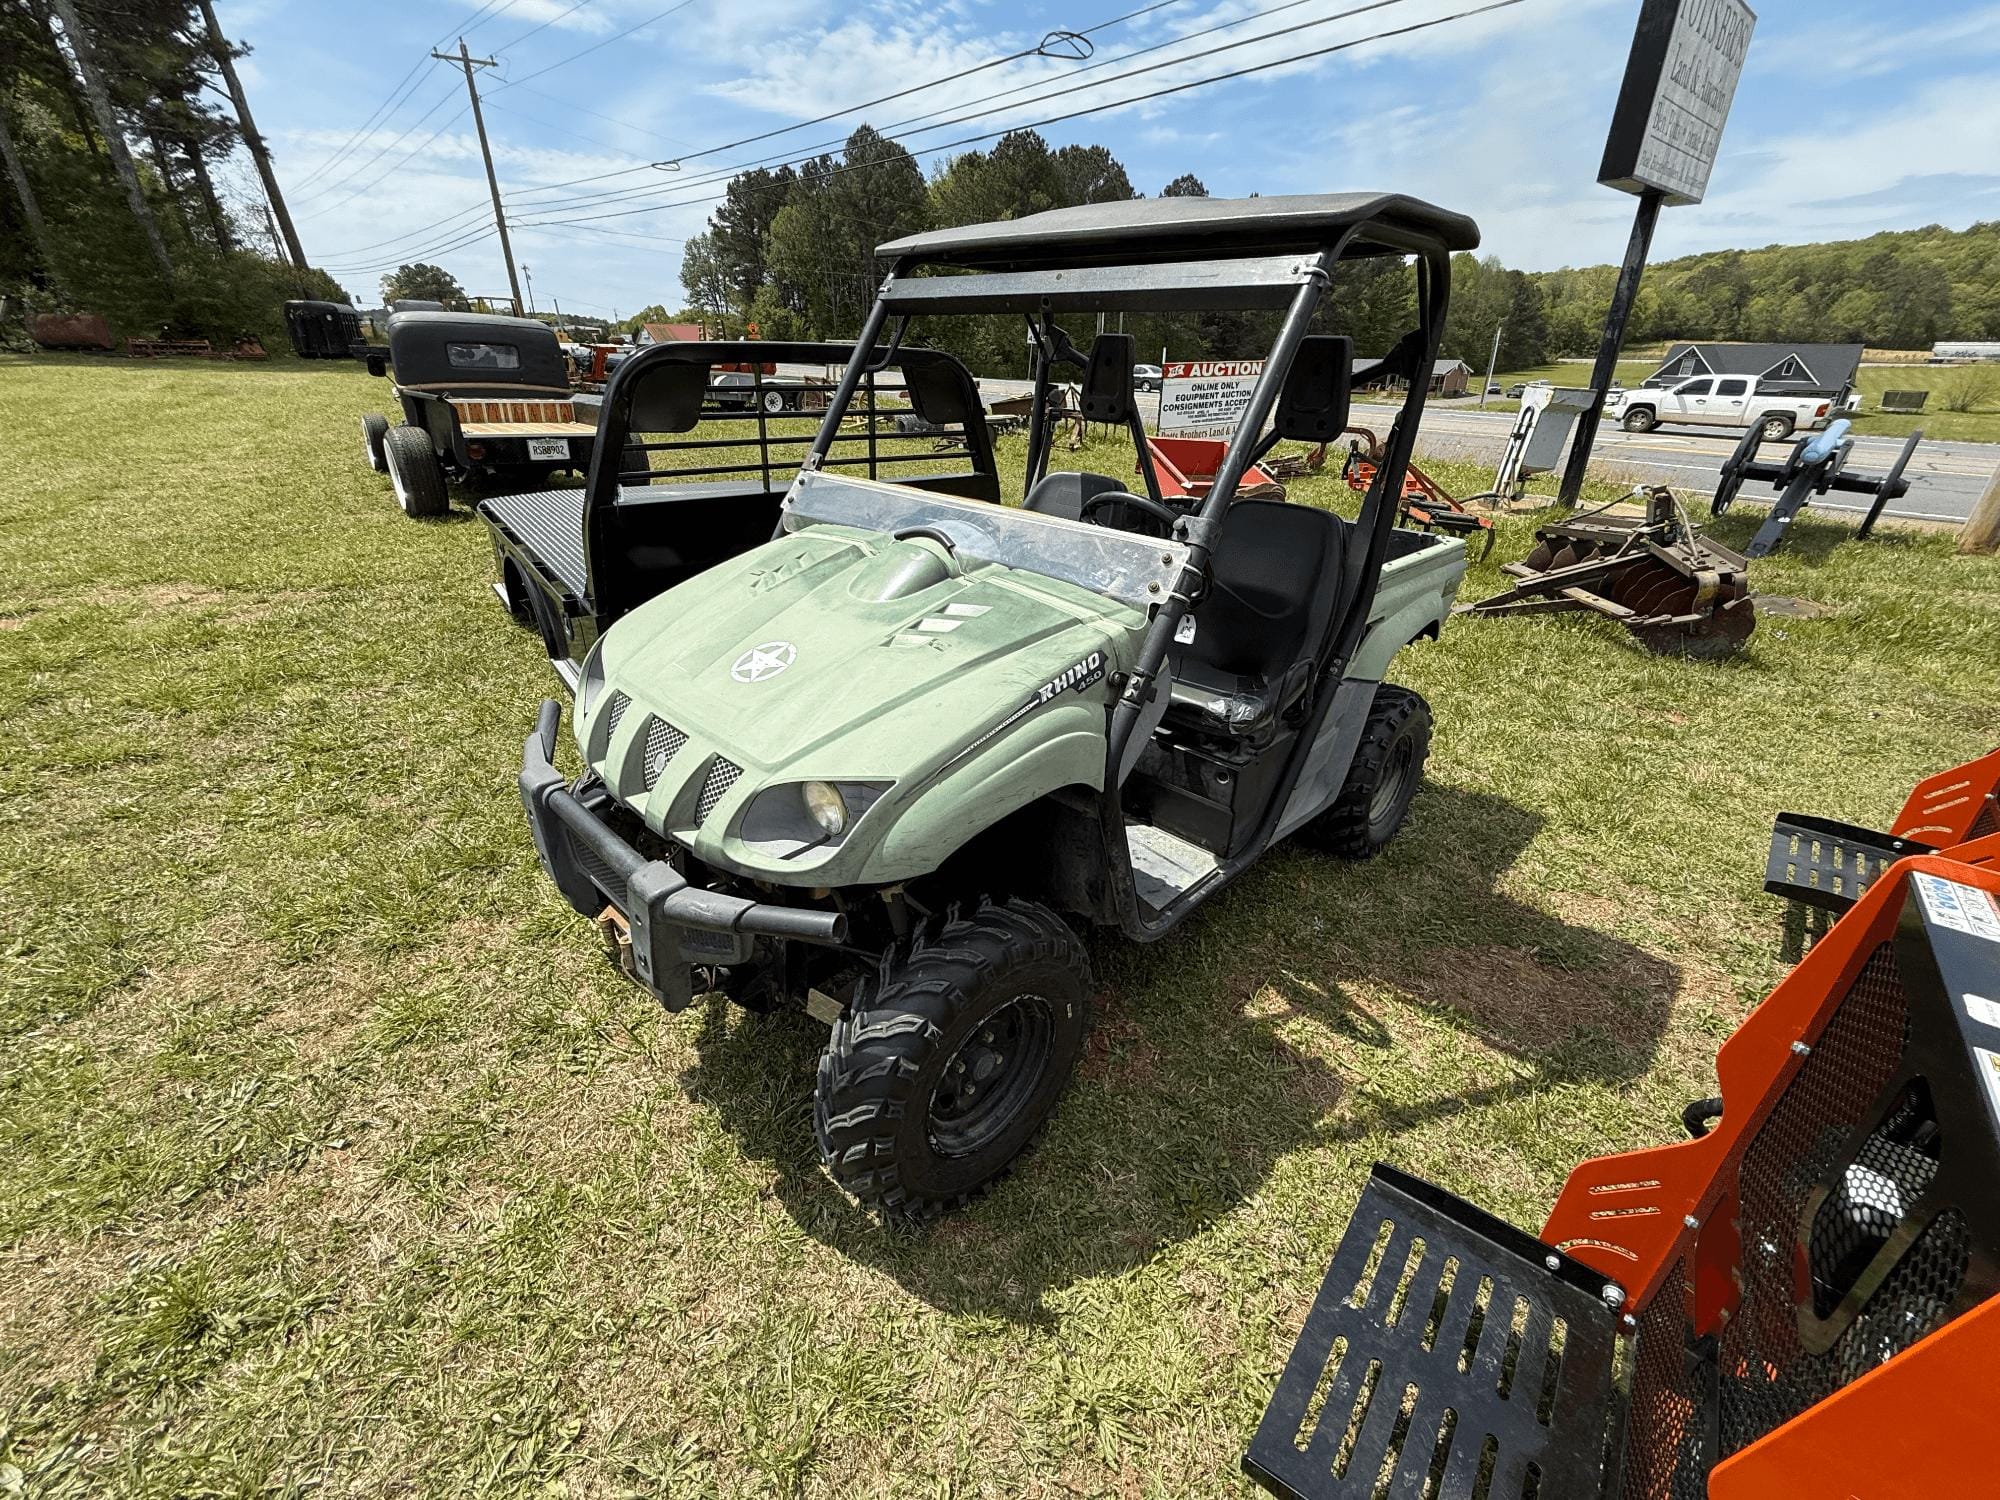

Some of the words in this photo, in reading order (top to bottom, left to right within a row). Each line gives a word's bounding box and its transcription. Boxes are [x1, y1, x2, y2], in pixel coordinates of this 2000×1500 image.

[1670, 43, 1696, 89] Land
[1688, 58, 1702, 96] &
[1190, 363, 1262, 376] AUCTION
[1192, 384, 1218, 392] ONLINE
[1221, 382, 1239, 390] ONLY
[1176, 392, 1219, 402] EQUIPMENT
[1221, 390, 1251, 398] AUCTION
[1163, 402, 1223, 412] CONSIGNMENTS
[1180, 428, 1208, 438] Brothers
[1209, 425, 1225, 437] Land
[1225, 424, 1231, 434] &
[1038, 652, 1100, 704] RHINO
[1078, 670, 1102, 691] 450
